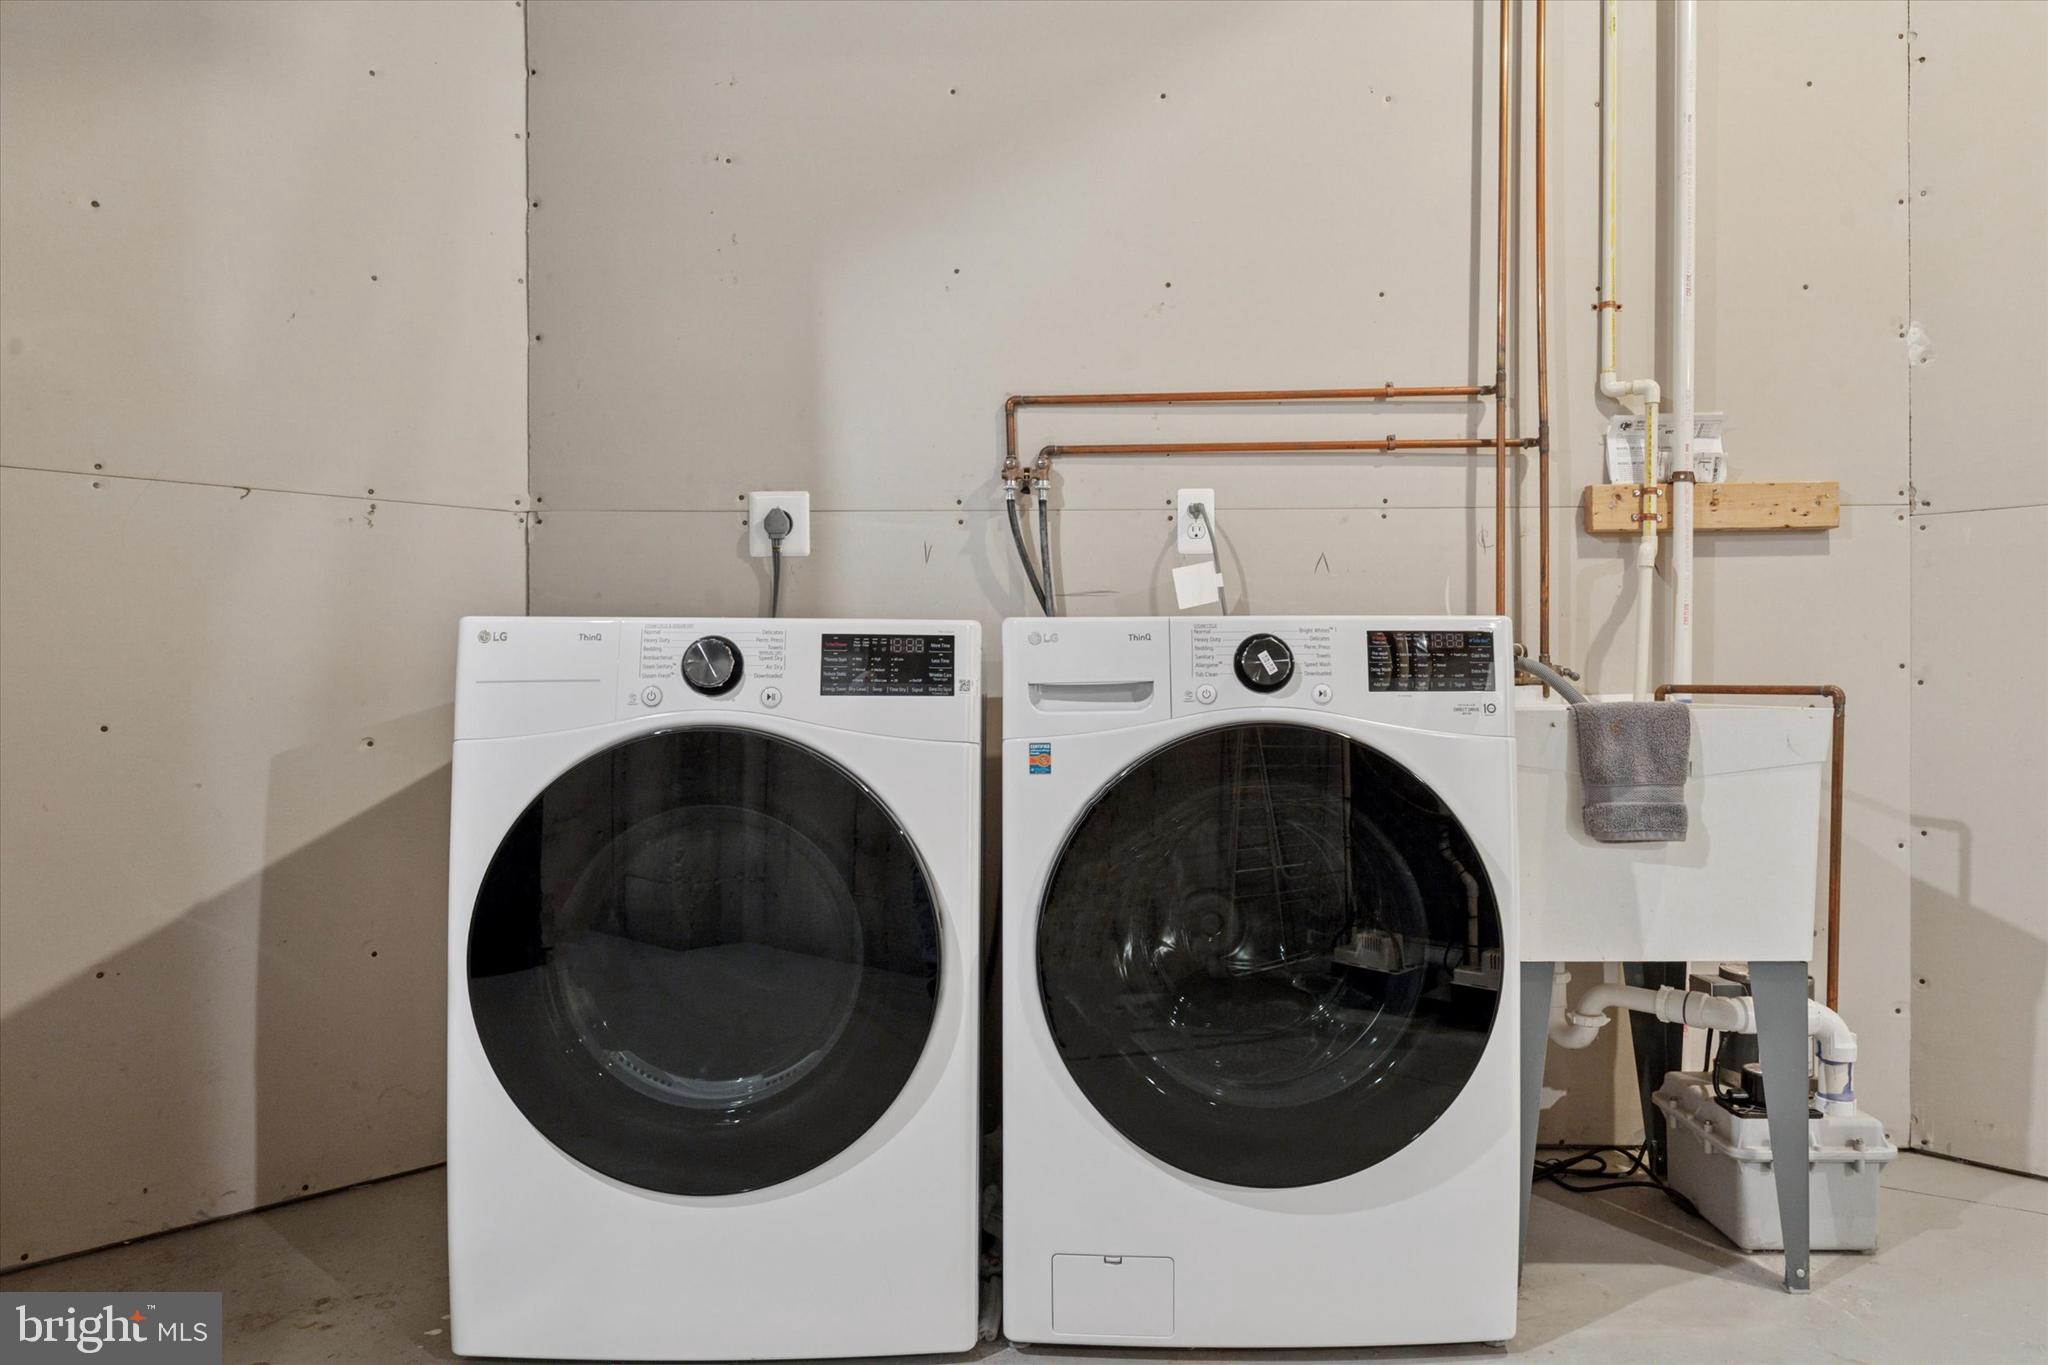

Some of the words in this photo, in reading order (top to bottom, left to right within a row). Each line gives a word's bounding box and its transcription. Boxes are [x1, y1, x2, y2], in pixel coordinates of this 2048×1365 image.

[493, 632, 508, 641] LG
[578, 633, 602, 641] ThinQ
[1043, 633, 1059, 643] LG
[1128, 633, 1151, 641] ThinQ
